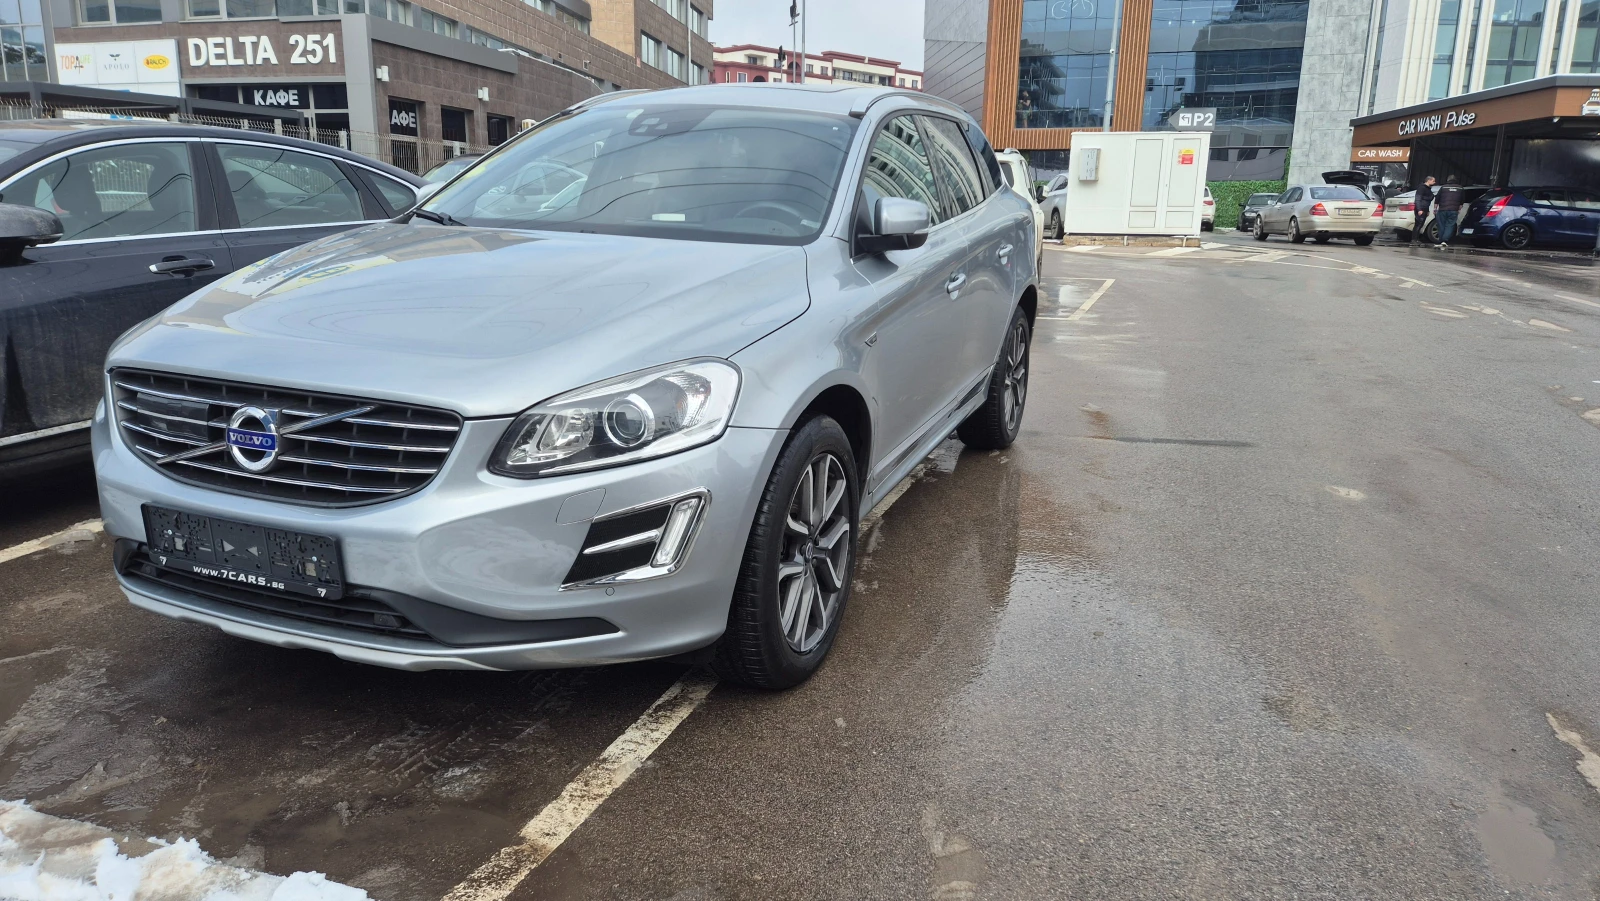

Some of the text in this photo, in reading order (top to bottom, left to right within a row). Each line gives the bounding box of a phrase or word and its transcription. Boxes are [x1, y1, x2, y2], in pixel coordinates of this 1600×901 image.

[187, 33, 337, 67] DELTA 251
[253, 89, 299, 106] КАФЕ
[1194, 112, 1214, 127] P2
[1398, 109, 1476, 136] CAR WASH Pulse
[1358, 149, 1377, 158] CAR
[1378, 149, 1403, 158] WASH
[229, 431, 273, 447] VOLVO
